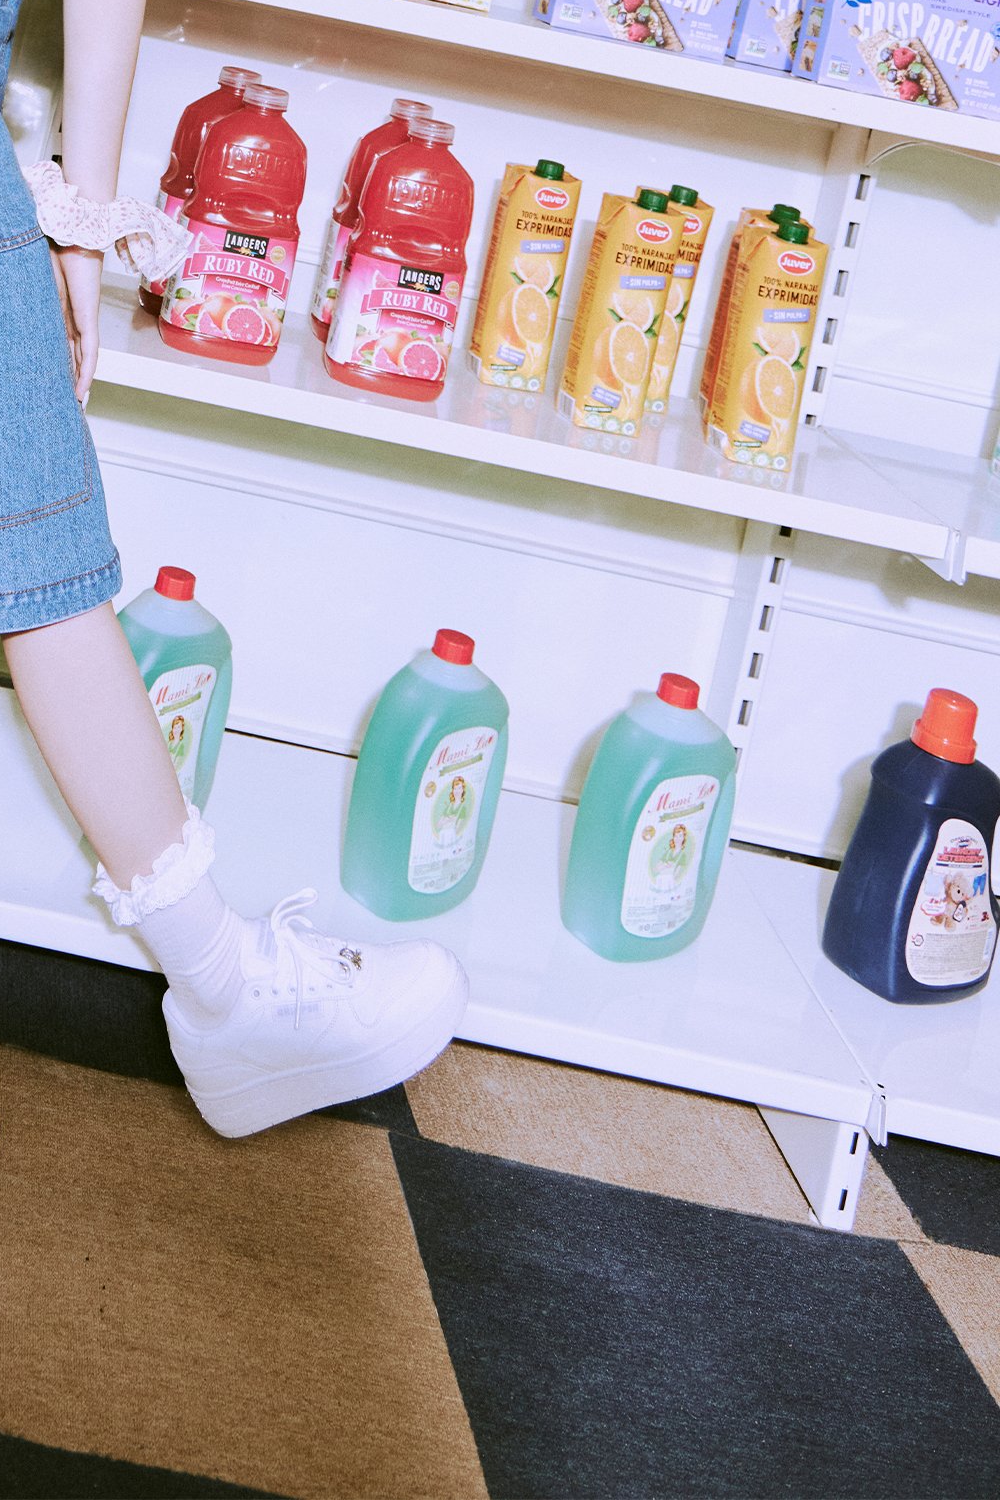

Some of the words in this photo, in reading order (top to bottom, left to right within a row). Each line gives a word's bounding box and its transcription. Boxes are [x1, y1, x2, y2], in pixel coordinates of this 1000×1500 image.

[539, 192, 567, 205] Juver
[516, 218, 573, 238] EXPRIMIDAS
[640, 224, 669, 239] Juver
[225, 233, 267, 256] LANGERS
[202, 255, 245, 274] RUBY
[247, 260, 275, 285] RED
[615, 252, 675, 275] EXPRIMIDAS
[781, 256, 811, 270] Juver
[400, 269, 442, 291] LANGERS
[381, 291, 421, 309] RUBY
[422, 295, 448, 318] RED
[758, 285, 819, 306] EXPRIMIDAS
